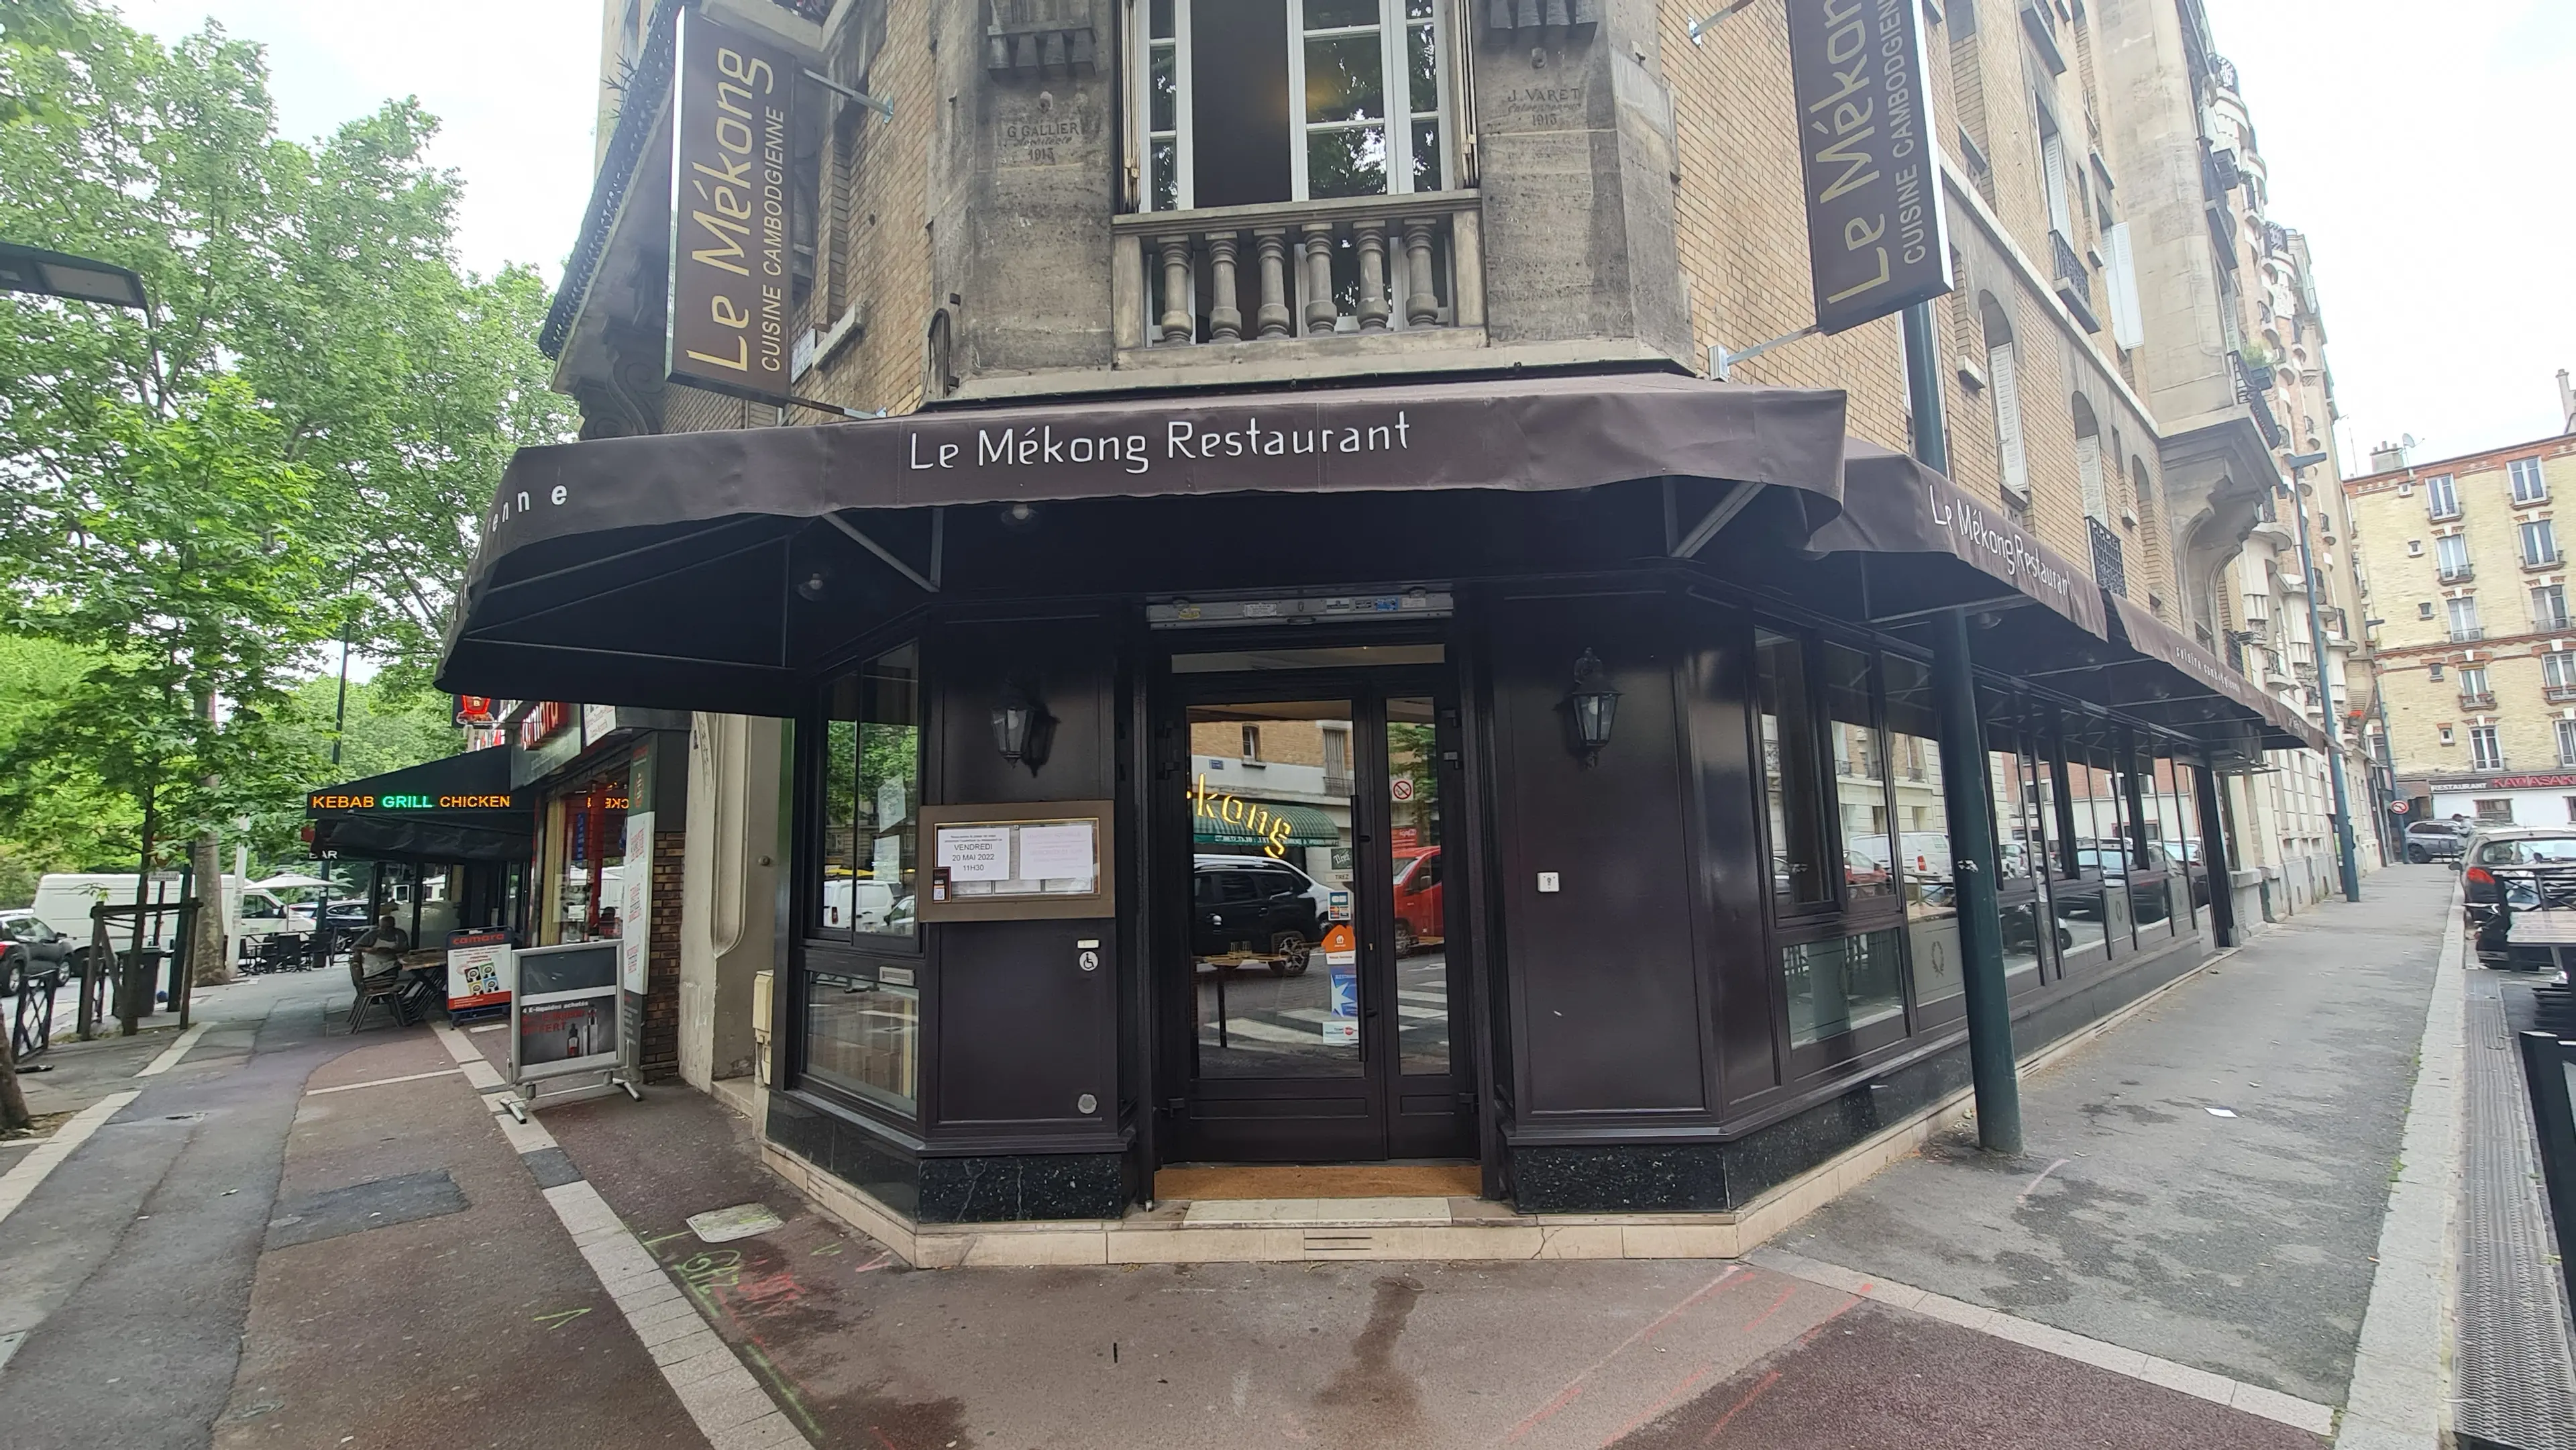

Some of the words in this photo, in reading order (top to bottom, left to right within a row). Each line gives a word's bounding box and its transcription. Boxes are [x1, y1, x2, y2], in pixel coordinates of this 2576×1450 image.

[1021, 122, 1079, 137] GALLIER
[1525, 88, 1580, 102] VARET
[691, 47, 774, 276] Mékong
[762, 107, 784, 276] CAMBODGIENNE
[1896, 163, 1926, 265] CUISINE
[1827, 213, 1890, 304] Le
[686, 294, 749, 372] Le
[761, 284, 782, 372] CUISINE
[910, 433, 959, 470] Le
[978, 425, 1149, 474] Mékong
[1167, 411, 1410, 460] Restaurant
[1929, 484, 1953, 531] Le
[1957, 499, 2015, 575] Mékong
[2015, 534, 2073, 599] Restaurant
[312, 796, 374, 809] KEBAB
[382, 796, 433, 808] GRILL
[439, 795, 511, 808] CHICKEN
[1186, 772, 1292, 859] kong
[2430, 782, 2487, 792] RESTAURANT
